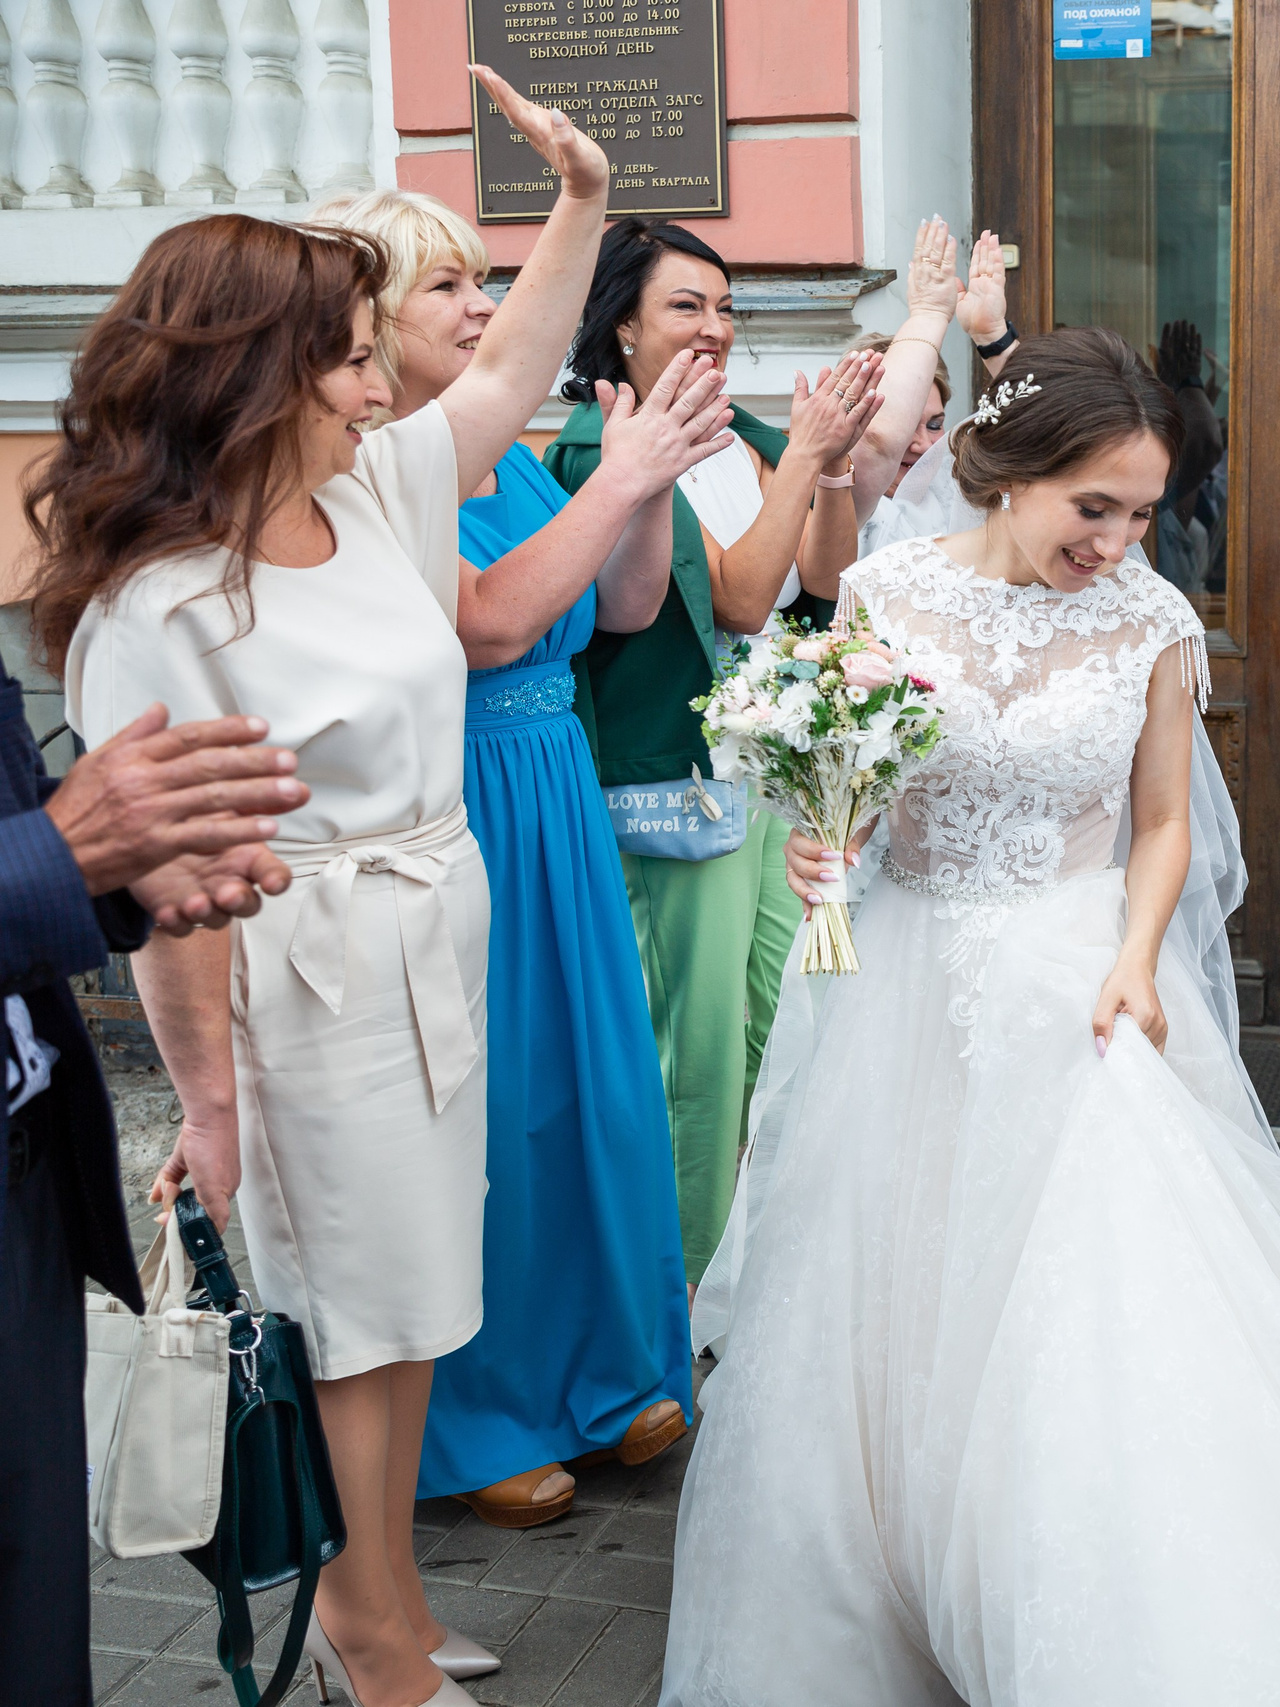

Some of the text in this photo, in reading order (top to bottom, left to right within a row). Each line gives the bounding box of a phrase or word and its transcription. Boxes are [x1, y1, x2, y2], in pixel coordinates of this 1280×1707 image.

[504, 3, 556, 13] СУББОТА
[1063, 5, 1141, 20] ПОД ОХРАНОЙ
[505, 16, 558, 28] ПЕРЕРЫВ
[583, 12, 615, 24] 13.00
[623, 12, 638, 24] ДО
[647, 8, 680, 21] 14.00
[529, 41, 655, 60] ВЫХОДНОЙ ДЕНЬ
[530, 79, 660, 96] ПРИЕМ ГРАЖДАН
[489, 94, 704, 115] НЬНИКОМ ОТДЕЛА ЗАГС
[586, 112, 616, 125] 14.00
[625, 113, 642, 125] ДО
[651, 109, 683, 122] 17.00
[587, 124, 684, 141] 10.00 ДО 13.00
[488, 175, 711, 194] ПОСЛЕДНИЙ ДЕНЬ КВАРТАЛА
[608, 793, 659, 809] LOVE
[626, 816, 700, 833] Novel Z
